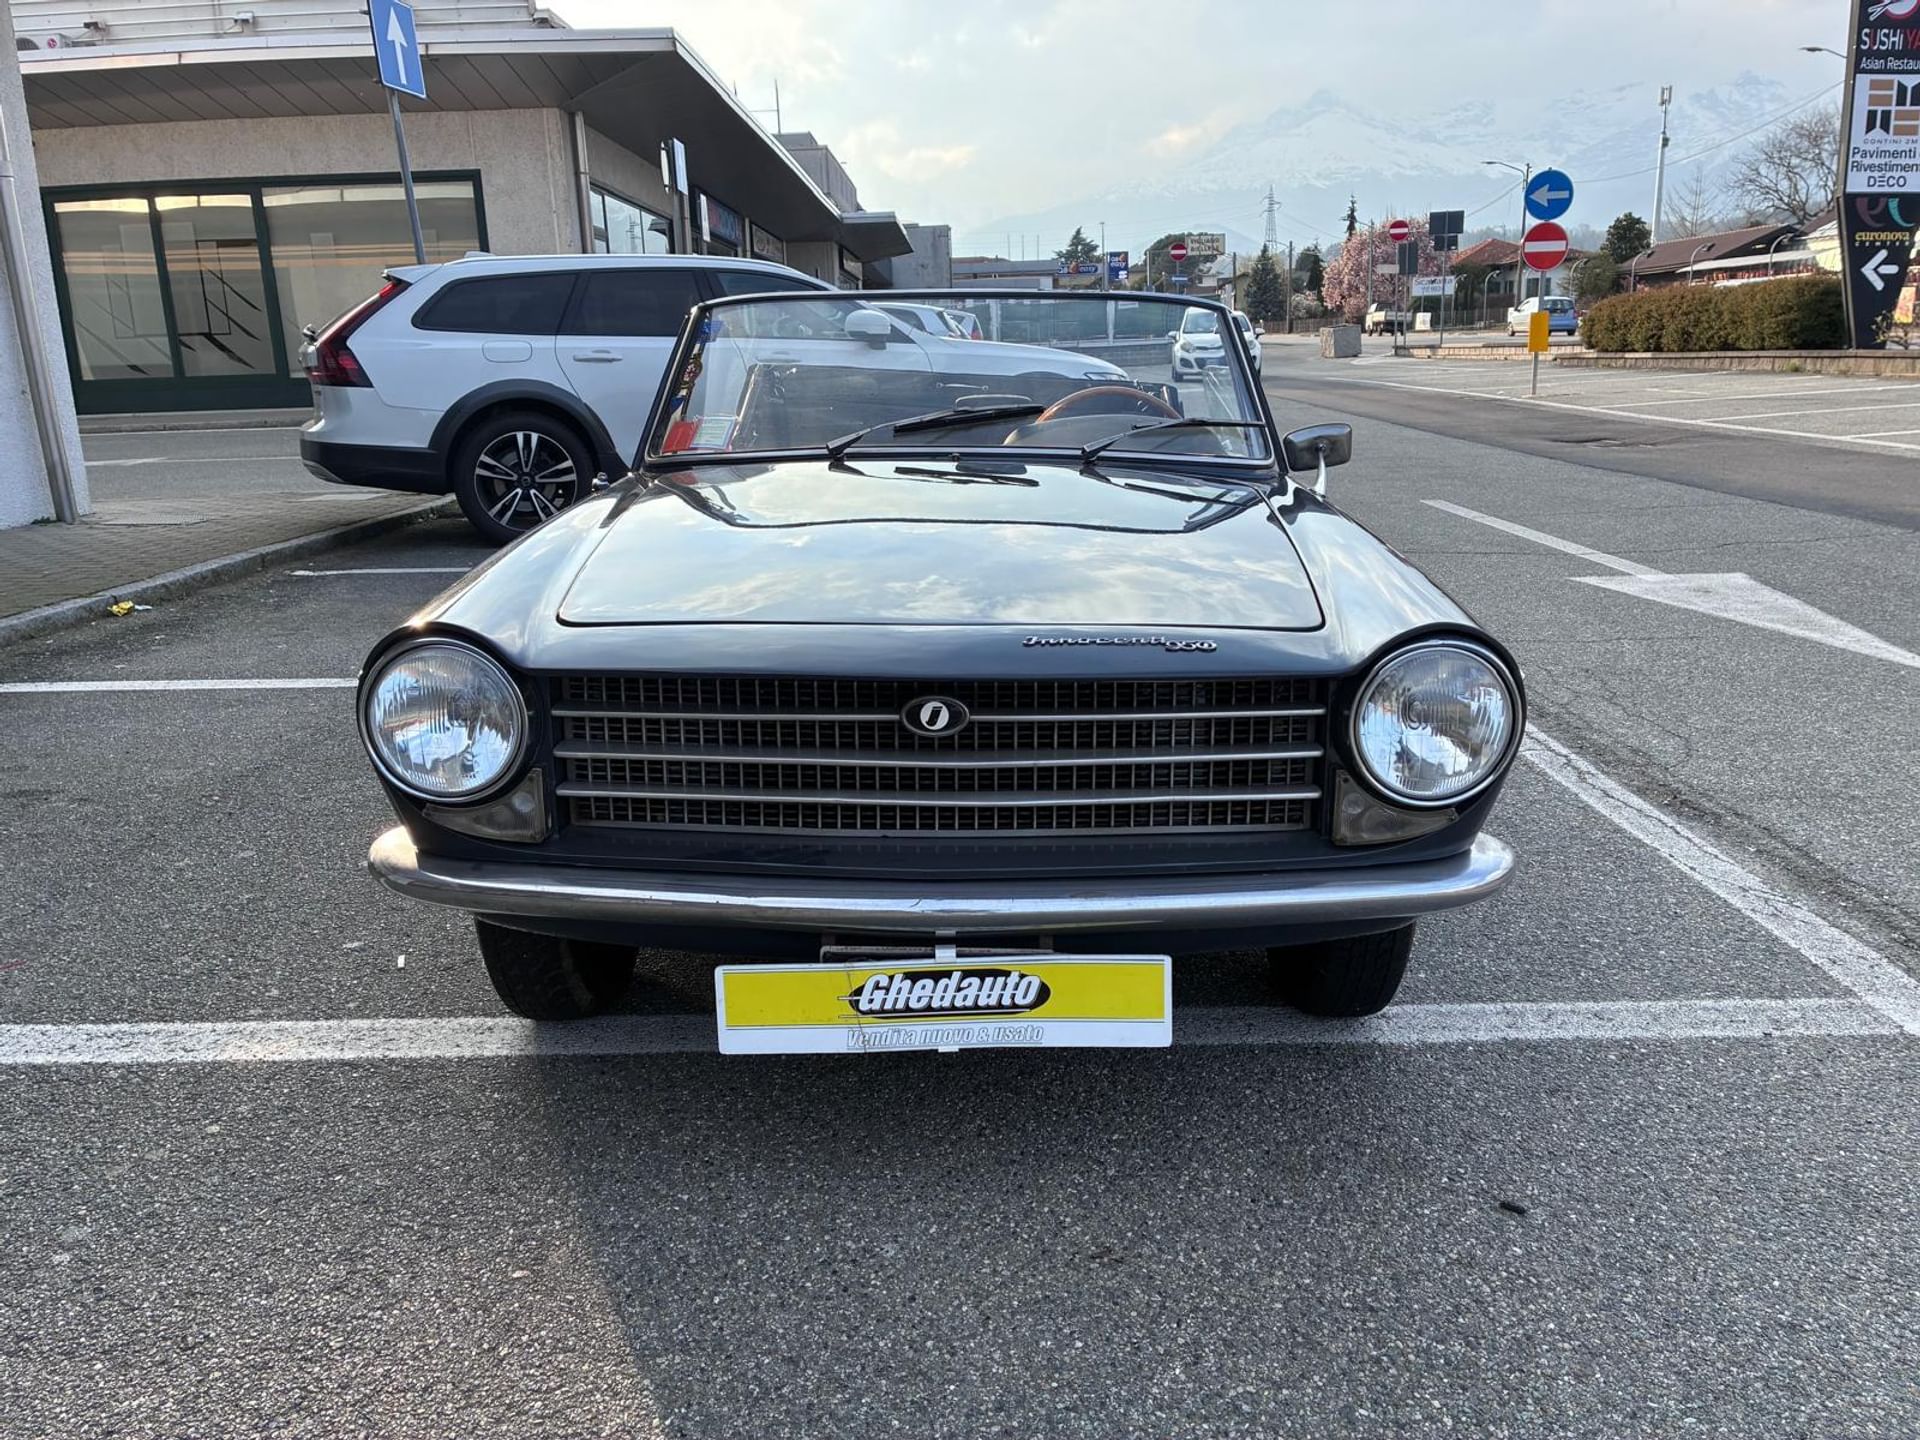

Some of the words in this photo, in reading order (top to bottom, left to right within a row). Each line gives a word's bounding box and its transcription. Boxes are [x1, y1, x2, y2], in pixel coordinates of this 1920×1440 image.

[1859, 56, 1885, 70] Asian
[1851, 146, 1917, 159] Pavimenti
[1855, 231, 1910, 241] euronova
[858, 972, 1043, 1015] Ghedauto
[847, 1028, 917, 1048] Vendita
[919, 1027, 974, 1046] nuovo
[976, 1027, 990, 1043] &
[992, 1024, 1044, 1043] usato
